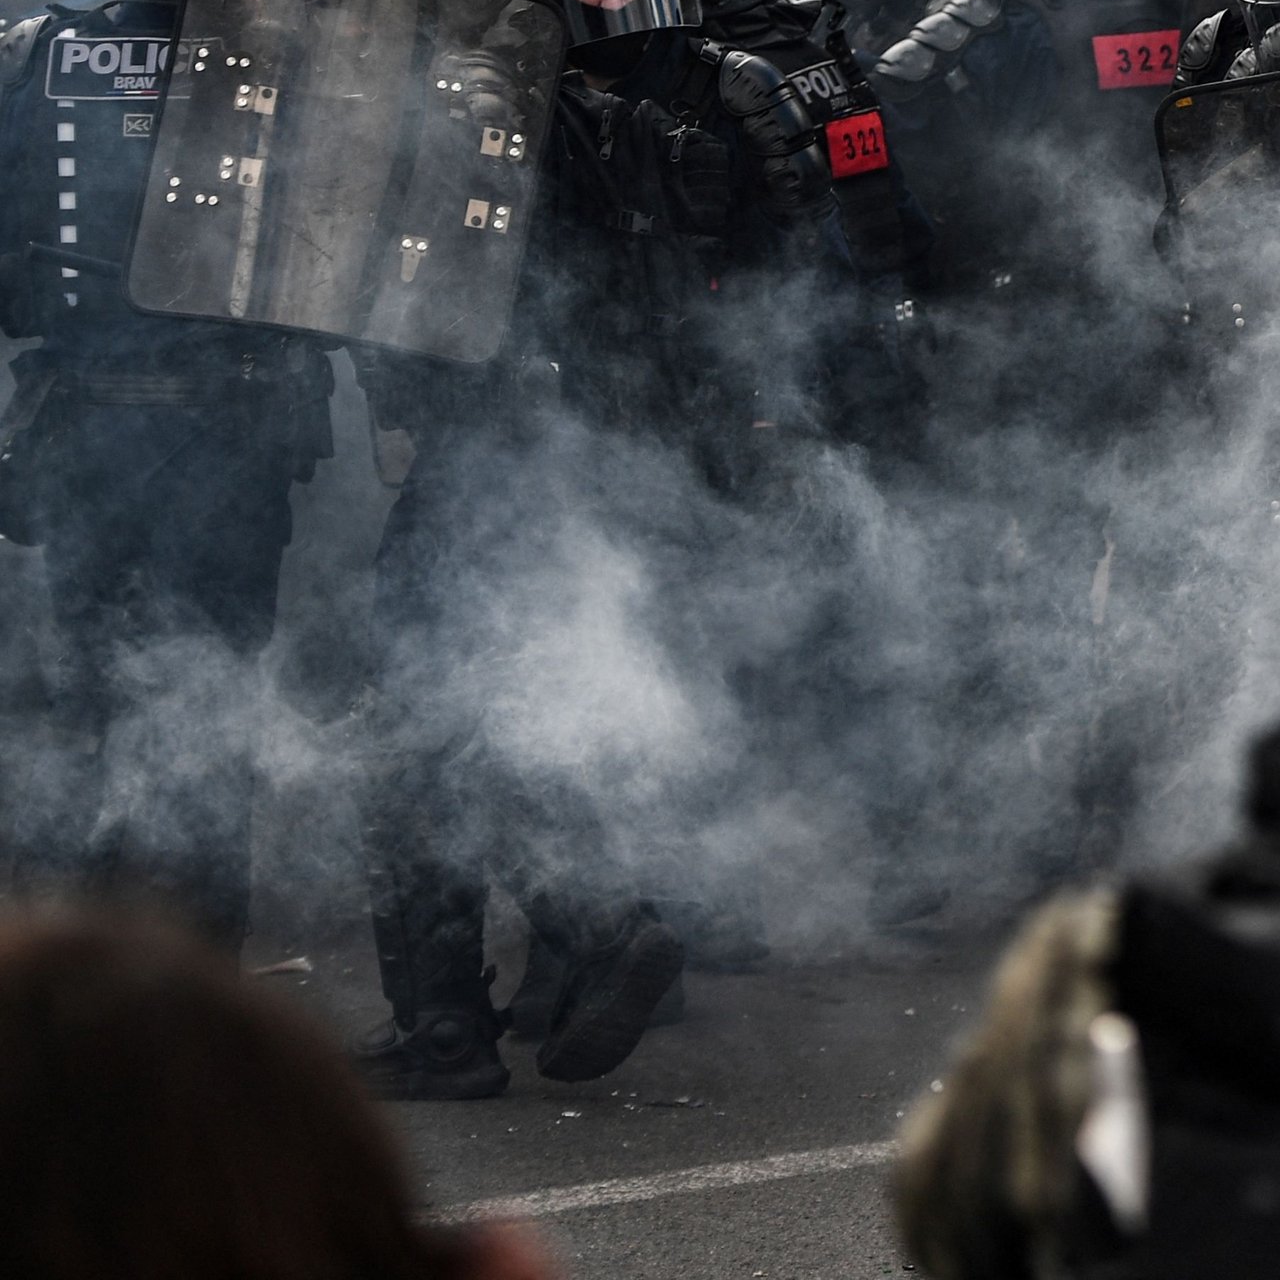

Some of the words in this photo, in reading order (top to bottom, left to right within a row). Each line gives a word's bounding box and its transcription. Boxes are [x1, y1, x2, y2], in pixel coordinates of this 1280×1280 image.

[1117, 45, 1174, 73] 322
[113, 76, 156, 89] BRAV
[843, 127, 881, 160] 322
